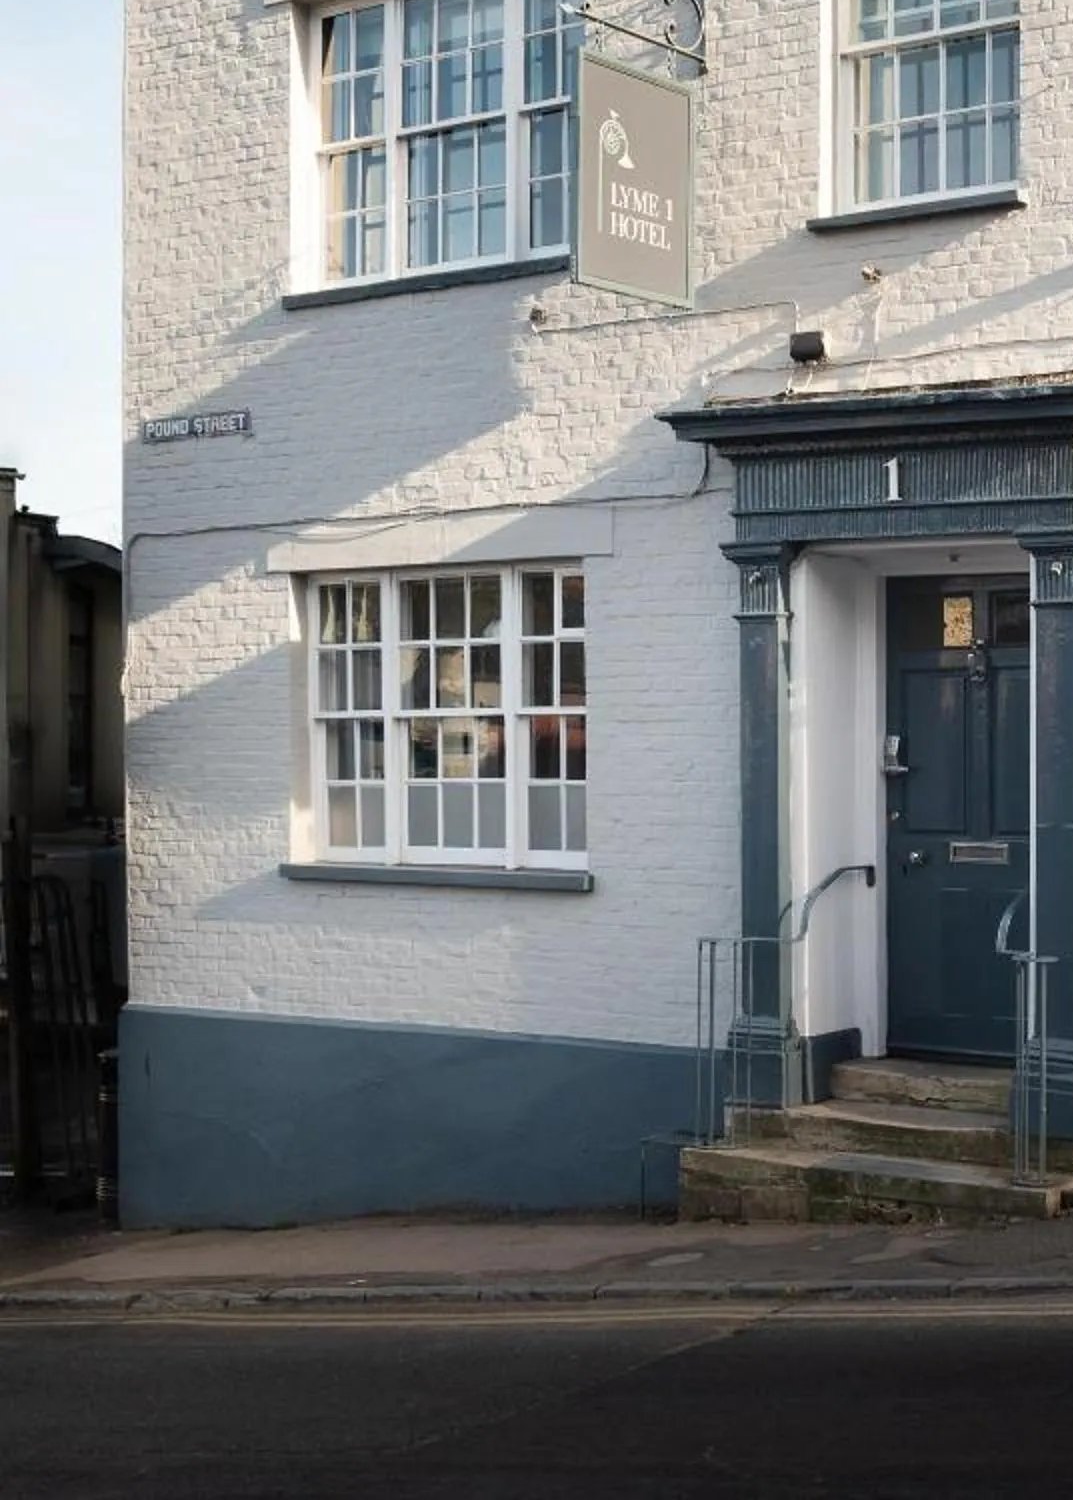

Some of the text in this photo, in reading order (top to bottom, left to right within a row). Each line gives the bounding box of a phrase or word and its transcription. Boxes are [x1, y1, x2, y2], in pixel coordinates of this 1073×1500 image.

[610, 181, 673, 221] LYME 1
[609, 211, 671, 250] HOTEL
[146, 413, 245, 438] POUND STREET
[882, 457, 903, 501] 1
